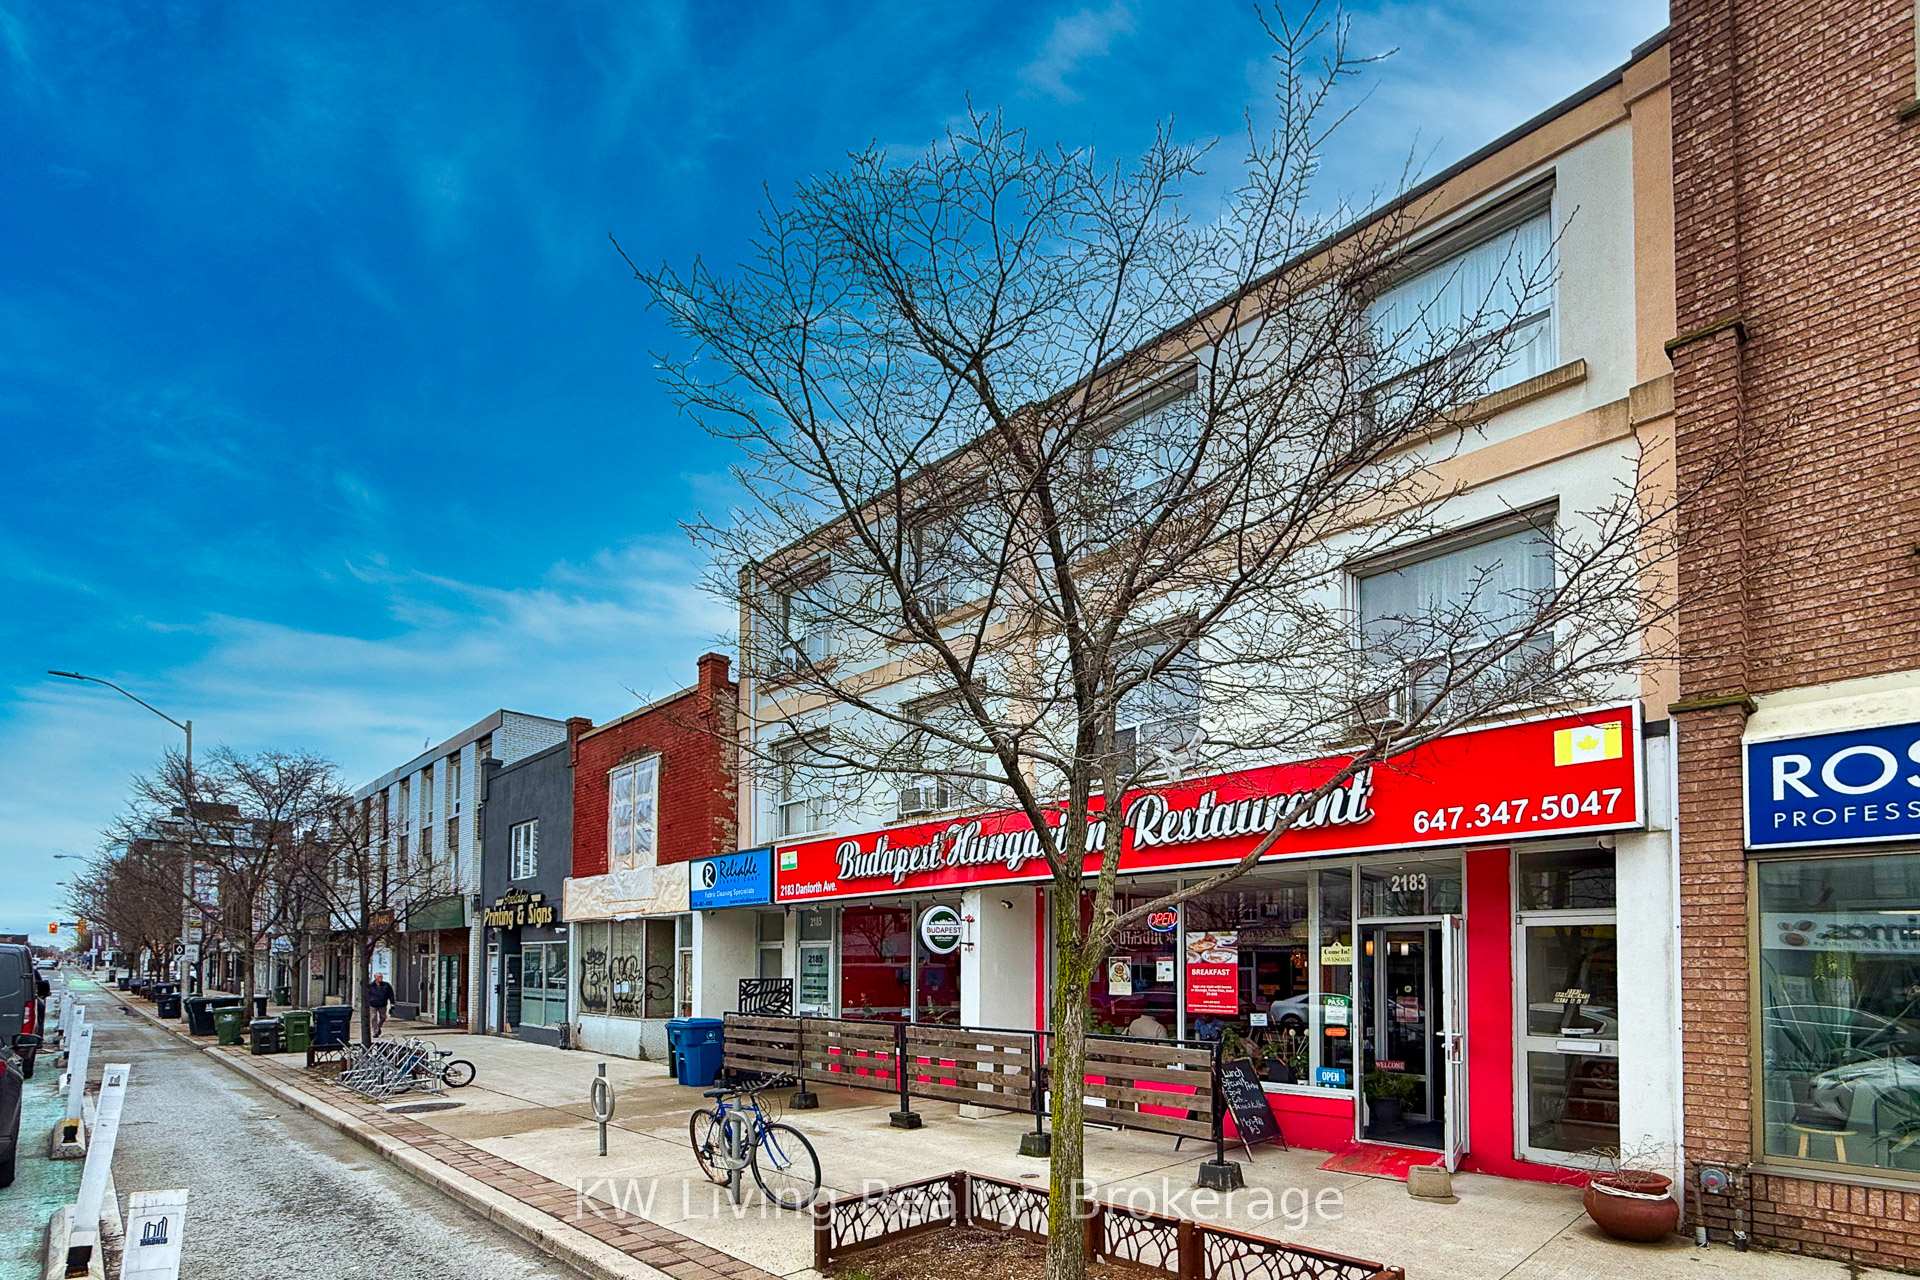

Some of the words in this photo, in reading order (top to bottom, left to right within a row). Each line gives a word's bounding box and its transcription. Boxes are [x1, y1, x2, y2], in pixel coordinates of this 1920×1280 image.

[1413, 787, 1622, 834] 647.347.5047
[1774, 801, 1920, 829] PROFESS
[836, 836, 944, 883] Budapest
[945, 820, 1106, 872] Hungain
[1125, 767, 1375, 848] Restaurant
[720, 856, 758, 878] Reliable
[780, 884, 795, 897] 2183
[795, 881, 822, 895] Danforth
[823, 880, 837, 892] Ave.
[1391, 873, 1427, 892] 2183
[484, 907, 514, 930] Printing
[517, 904, 525, 925] &
[528, 903, 552, 928] Signs
[1151, 912, 1177, 926] OPEN
[927, 926, 961, 934] BUDAPEST
[1191, 968, 1231, 976] BREAKFAST
[1321, 1071, 1340, 1082] OPEN
